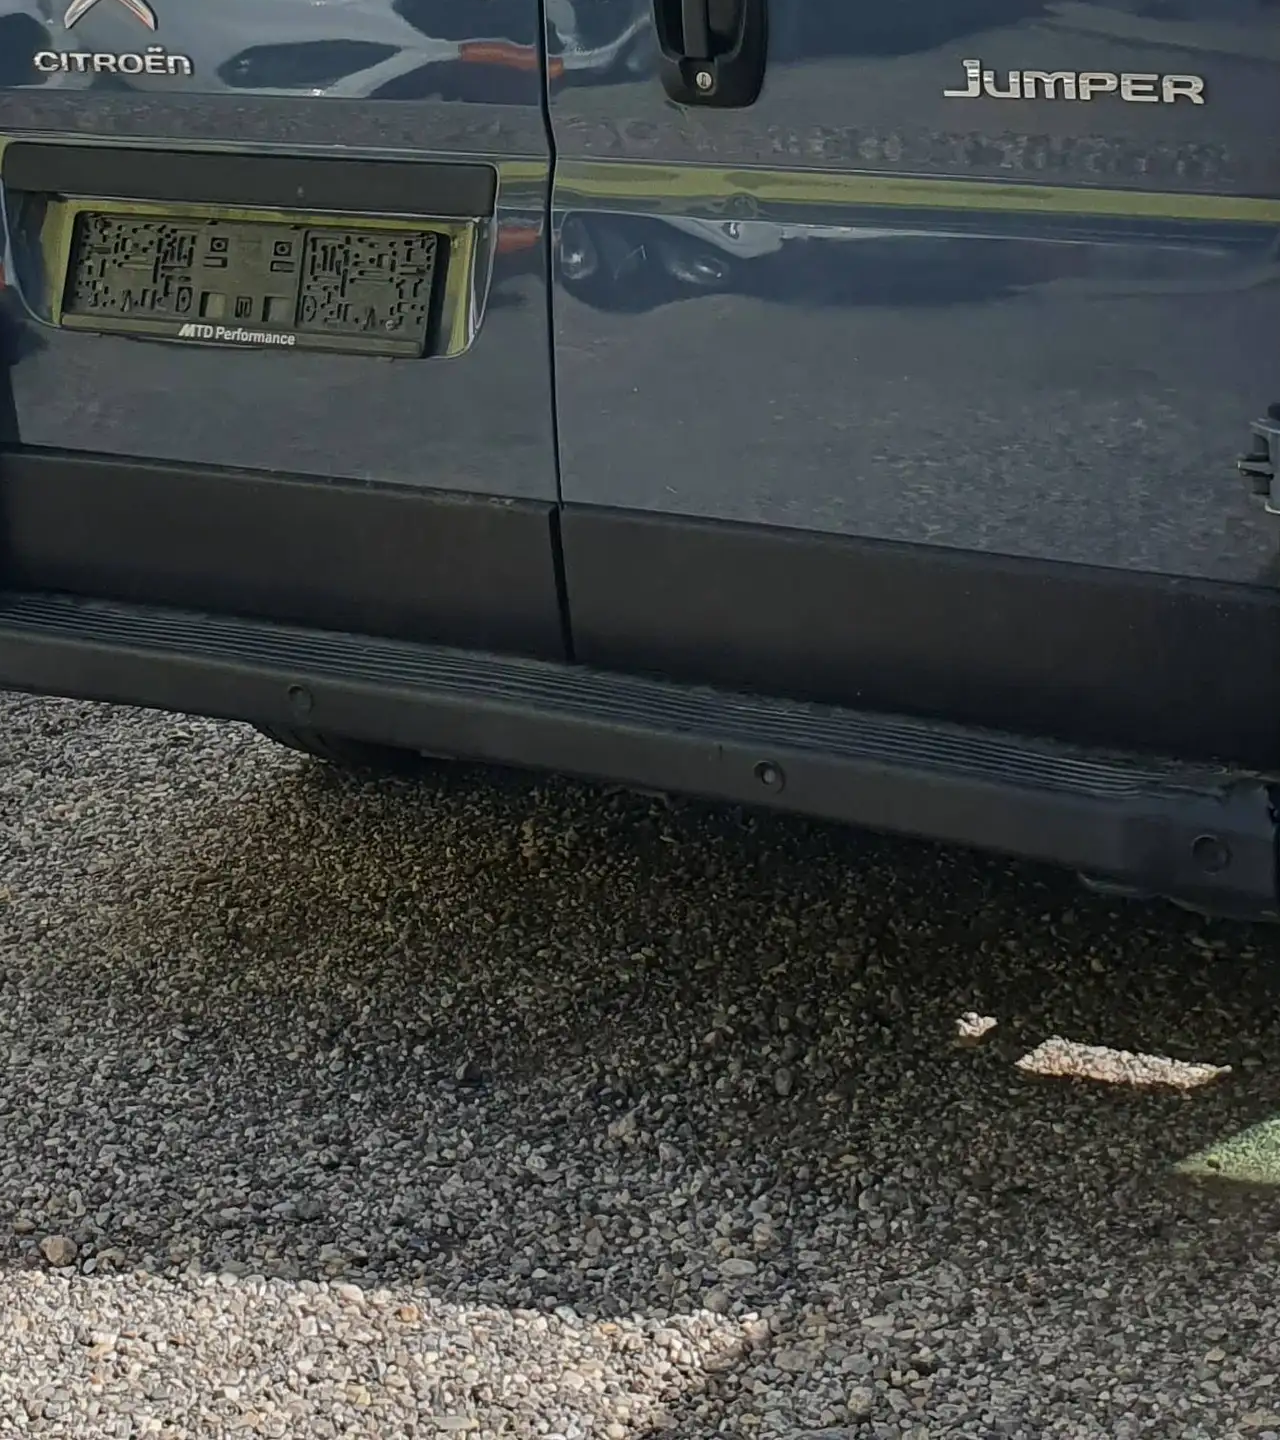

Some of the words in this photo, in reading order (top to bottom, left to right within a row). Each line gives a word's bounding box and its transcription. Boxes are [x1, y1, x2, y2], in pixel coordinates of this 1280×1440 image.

[944, 59, 1205, 105] JUMPER
[178, 323, 213, 339] MTD
[215, 326, 296, 346] Performance
